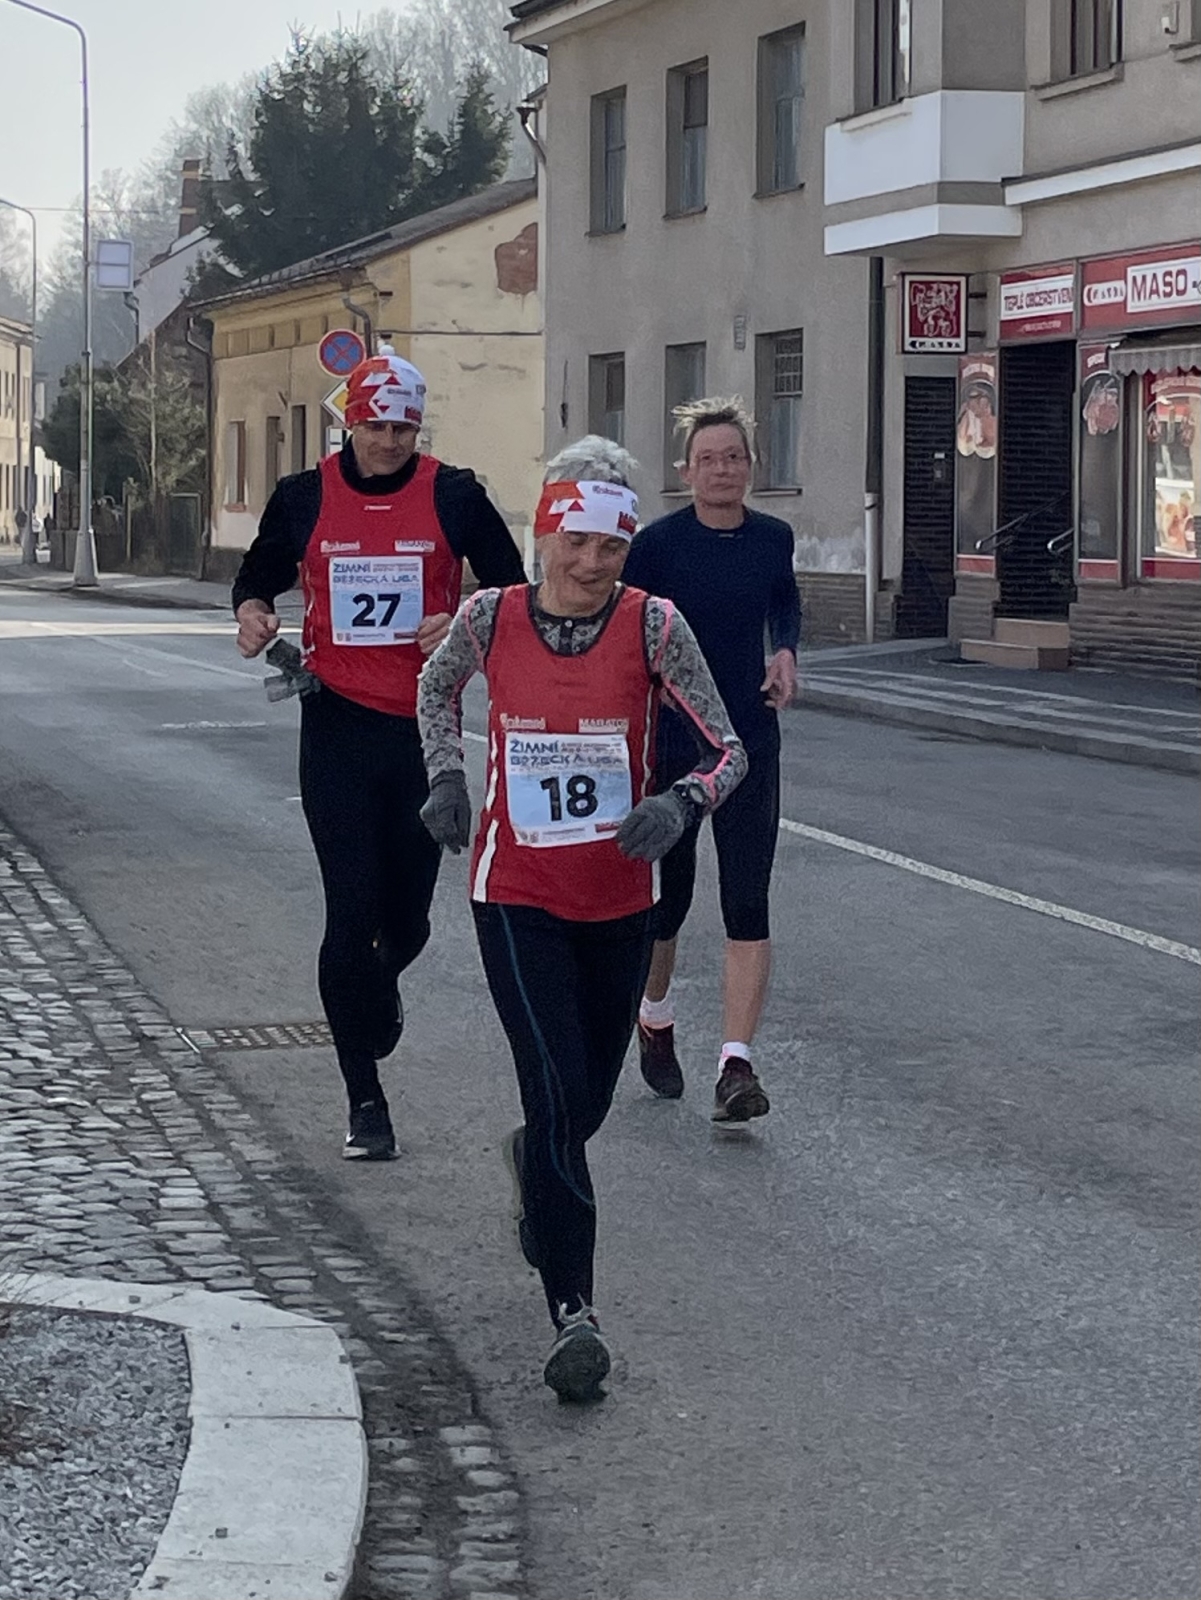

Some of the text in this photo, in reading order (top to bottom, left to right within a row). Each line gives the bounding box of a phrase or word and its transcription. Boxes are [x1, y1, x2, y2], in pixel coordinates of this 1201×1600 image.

[1131, 268, 1188, 303] MASO
[351, 593, 401, 627] 27
[539, 774, 598, 821] 18
